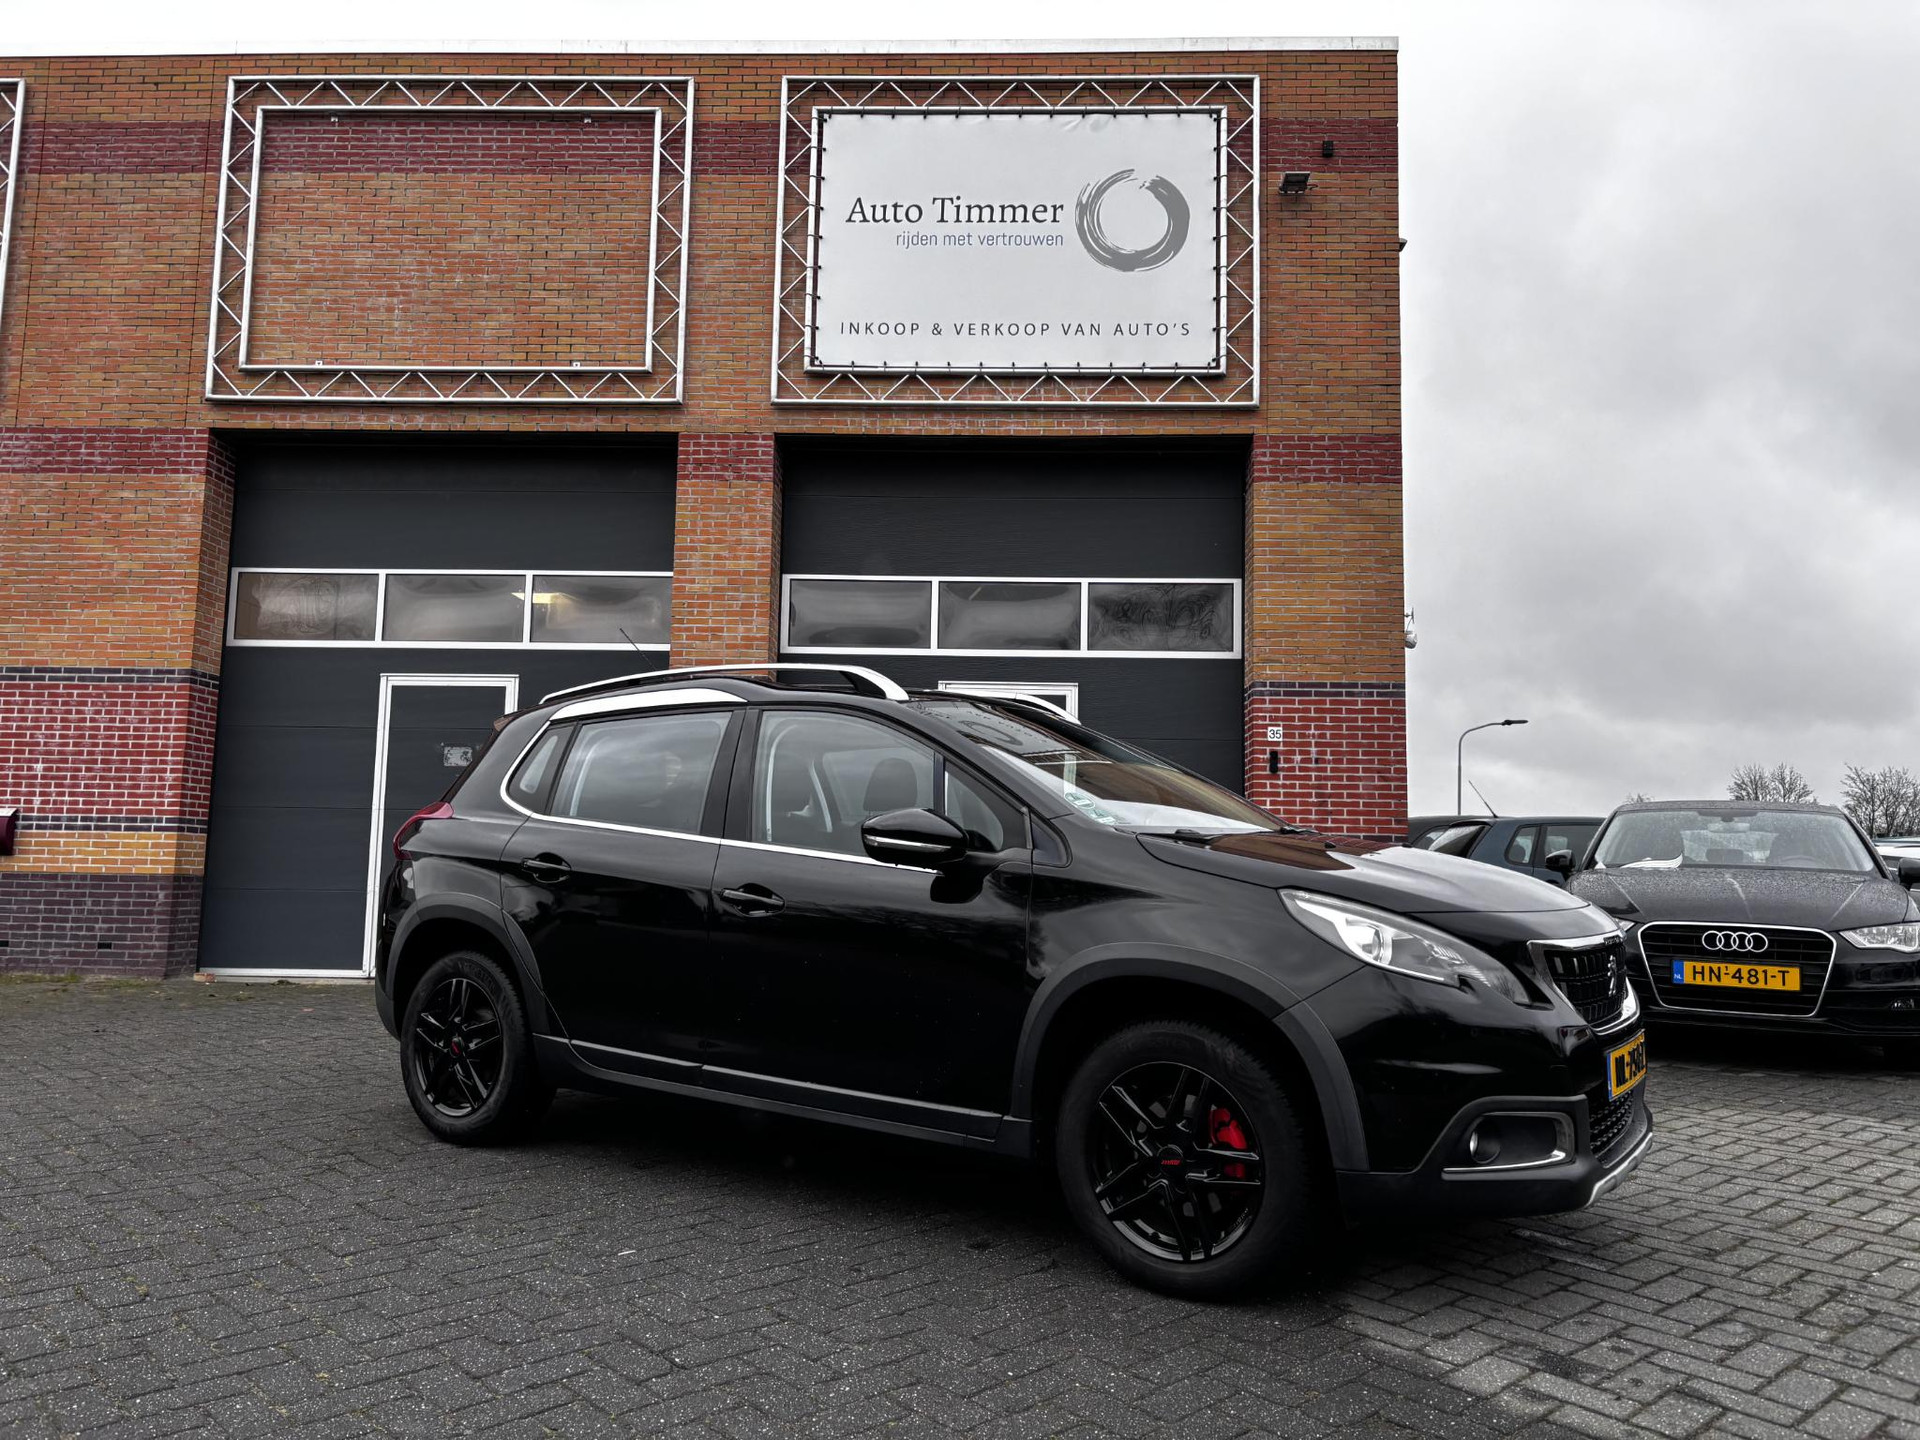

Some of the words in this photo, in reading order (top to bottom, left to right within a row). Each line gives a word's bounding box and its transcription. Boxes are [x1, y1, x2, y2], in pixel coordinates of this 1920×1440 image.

[845, 196, 923, 224] Auto
[931, 195, 1064, 224] Timmer
[896, 230, 938, 250] rijden
[943, 232, 973, 247] met
[977, 232, 1064, 247] vertrouwen
[840, 321, 920, 336] INKOOP
[931, 322, 943, 336] &
[953, 322, 1050, 337] VERKOOP
[1061, 323, 1101, 336] VAN
[1113, 322, 1190, 337] AUTO'S
[1269, 728, 1282, 740] 35
